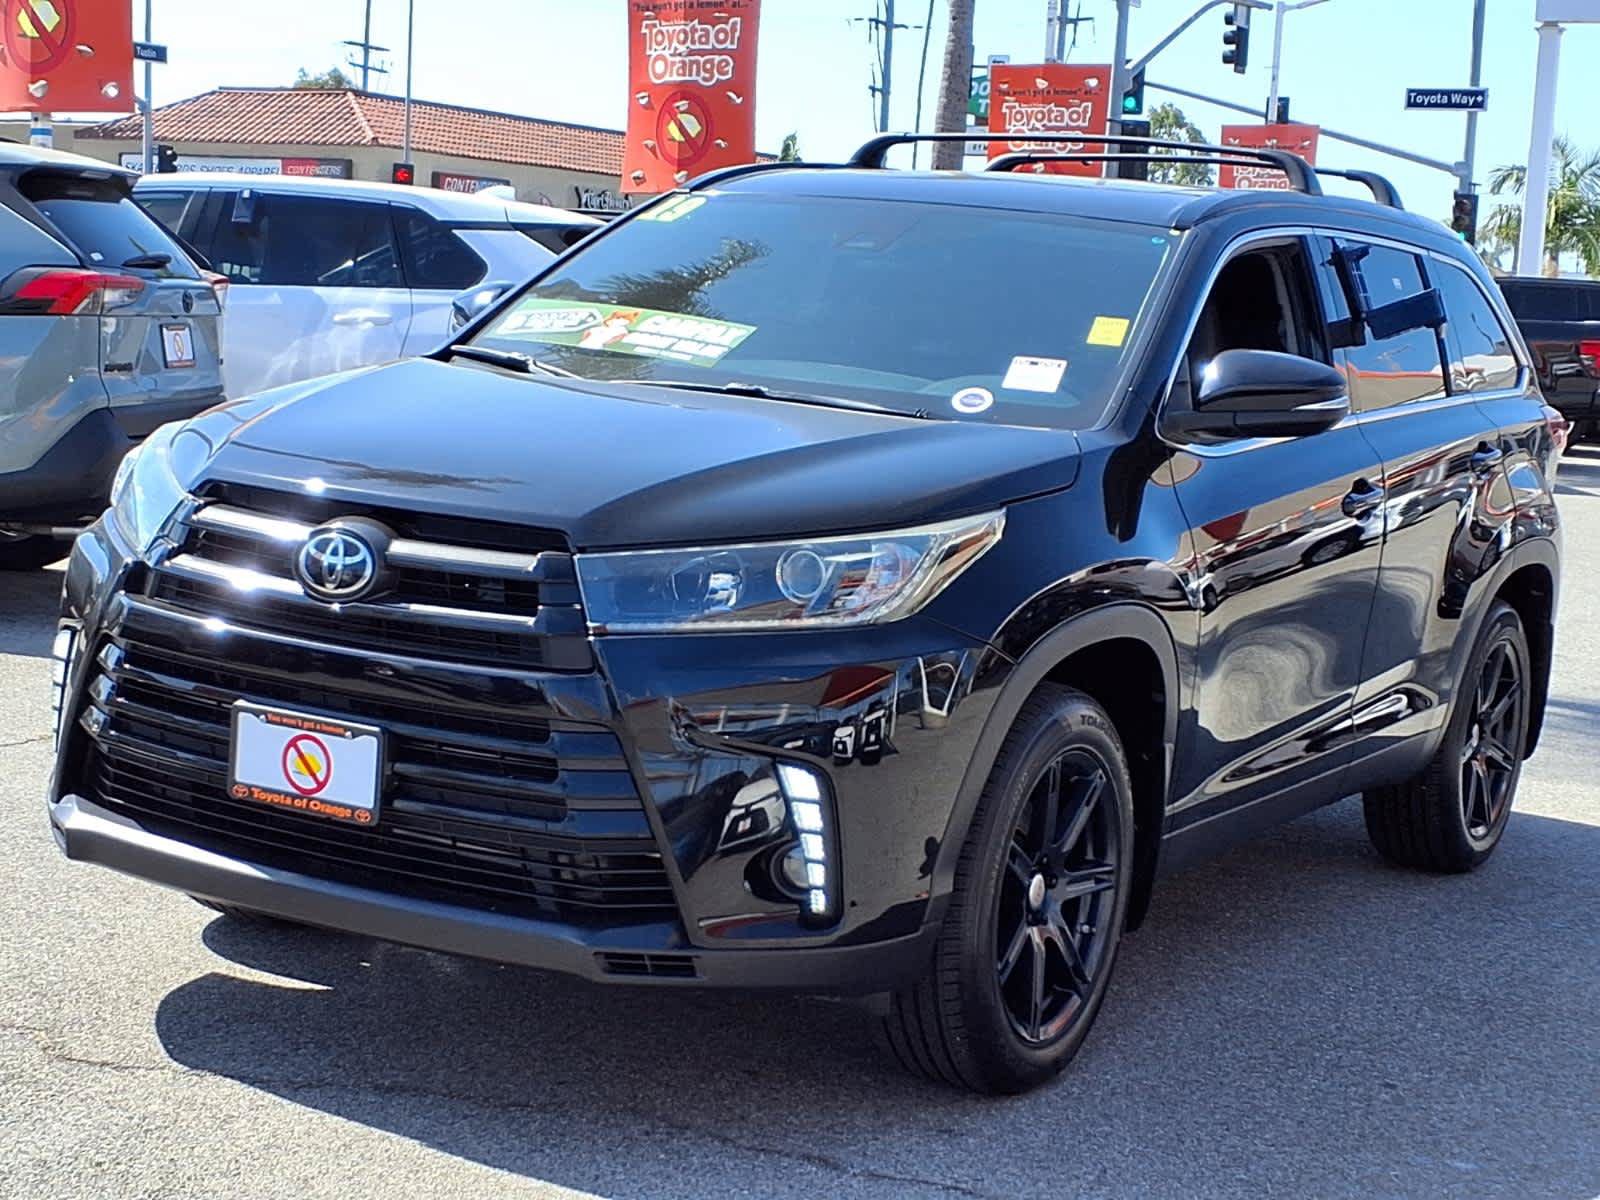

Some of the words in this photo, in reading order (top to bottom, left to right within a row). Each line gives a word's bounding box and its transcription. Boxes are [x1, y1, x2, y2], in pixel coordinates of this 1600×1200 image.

[641, 18, 712, 55] Toyota
[713, 17, 741, 49] of
[648, 53, 733, 86] Orange
[1409, 92, 1448, 106] Toyota
[1451, 92, 1475, 106] Way
[1002, 103, 1066, 130] Toyota
[1067, 102, 1092, 127] of
[250, 786, 293, 805] Toyota
[294, 797, 307, 809] of
[309, 799, 353, 818] Orange
